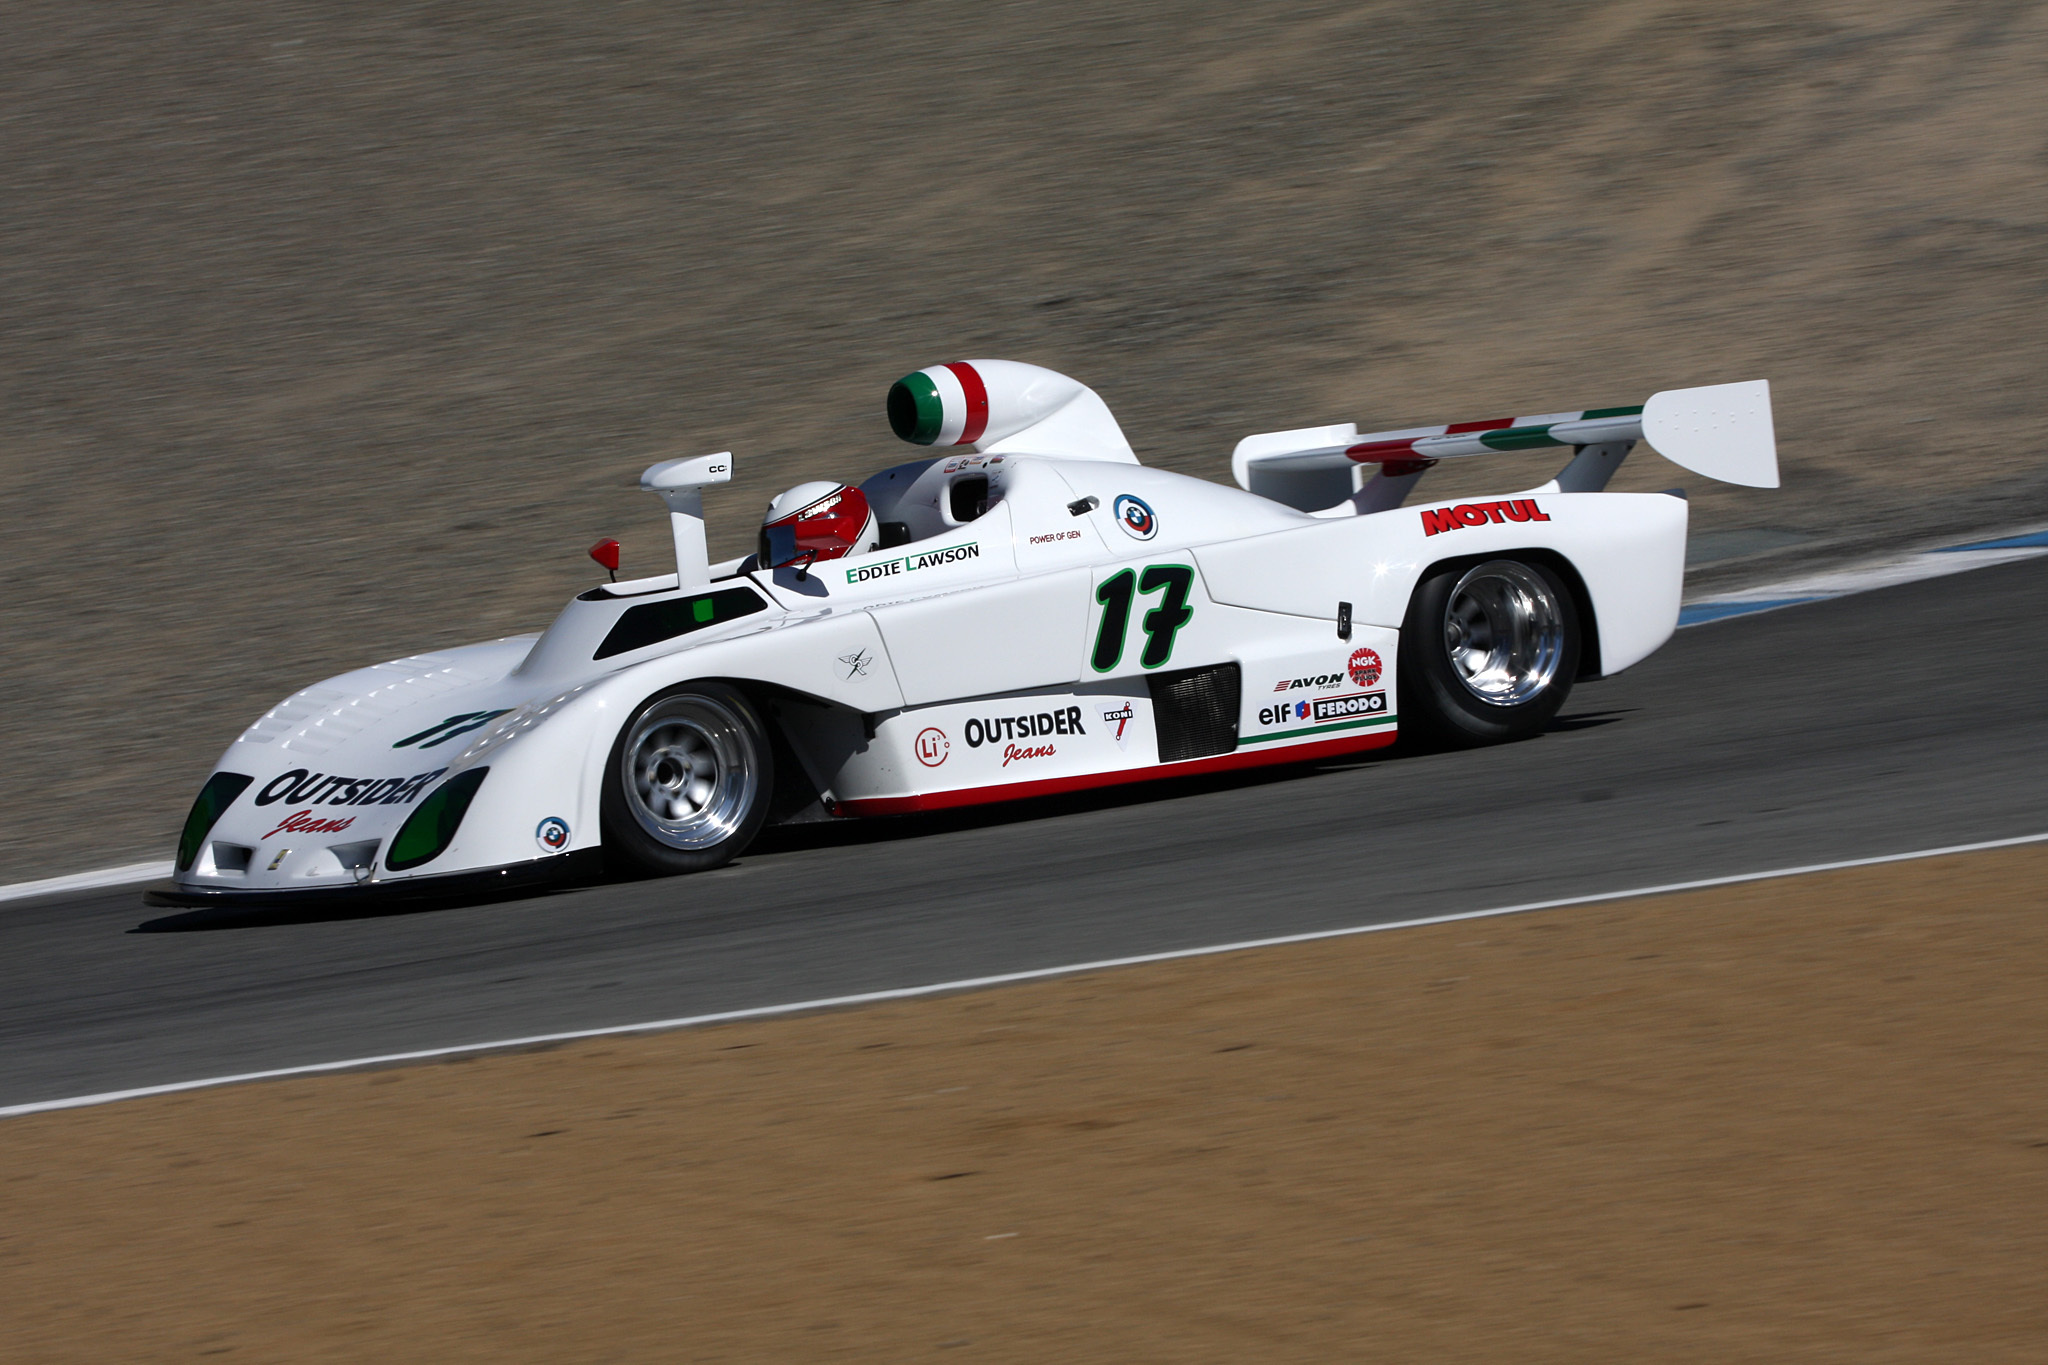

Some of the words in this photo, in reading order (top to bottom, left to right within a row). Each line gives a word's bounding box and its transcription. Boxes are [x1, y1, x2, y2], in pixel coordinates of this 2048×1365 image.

[1420, 499, 1551, 537] MOTUL
[1029, 533, 1055, 545] POWER
[1056, 532, 1065, 541] OF
[846, 558, 900, 584] EDDIE
[905, 543, 979, 572] LAWSON
[1091, 564, 1195, 673] 17
[1351, 655, 1377, 668] NGK
[1354, 668, 1377, 676] SPARK
[1289, 673, 1344, 690] AVON
[1317, 682, 1341, 691] TYRES
[1104, 710, 1132, 721] KONI
[1258, 703, 1291, 725] elf
[1317, 696, 1382, 717] FERODO
[964, 706, 1086, 748] OUTSIDER
[1002, 743, 1056, 768] Jeans
[254, 767, 450, 807] OUTSIDER
[260, 809, 357, 841] Jeans
